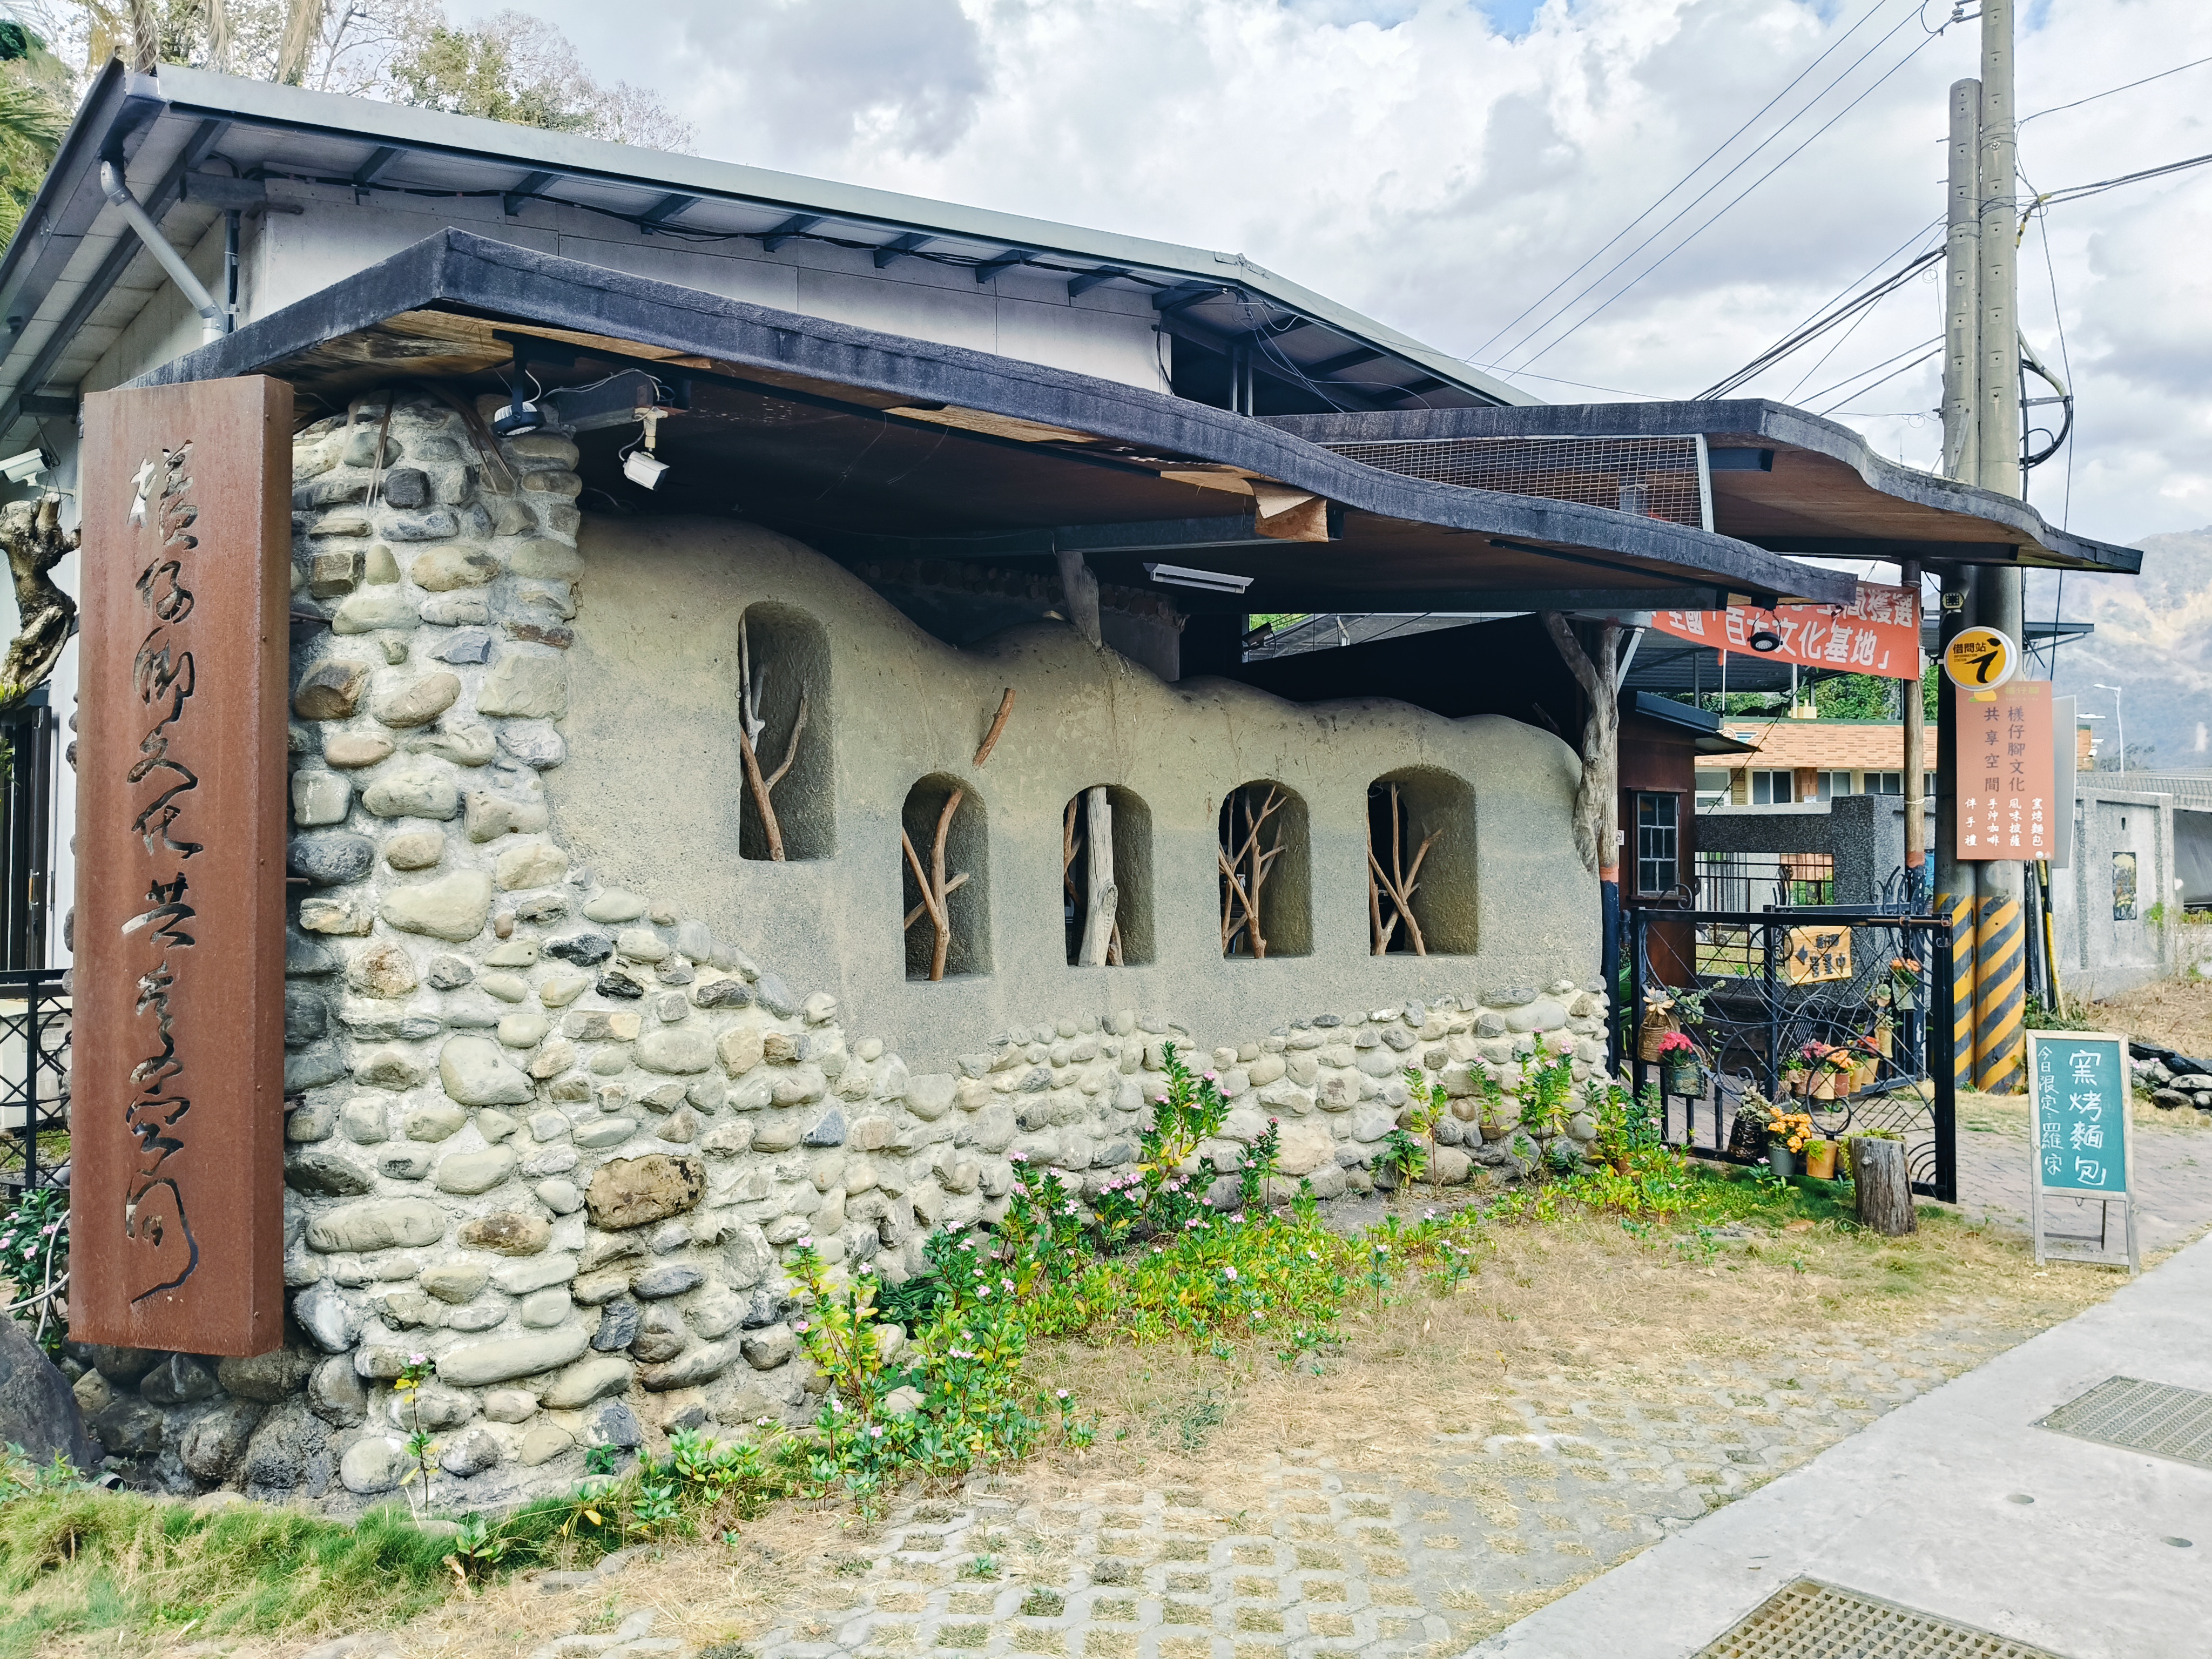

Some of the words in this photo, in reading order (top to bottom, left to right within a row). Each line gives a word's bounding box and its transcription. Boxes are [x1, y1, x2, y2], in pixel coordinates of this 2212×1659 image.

[1953, 642, 1986, 654] 借問站
[1984, 707, 2000, 792] 共享空間
[1965, 797, 1978, 846] 伴手禮
[2008, 798, 2022, 847] 風味披薩
